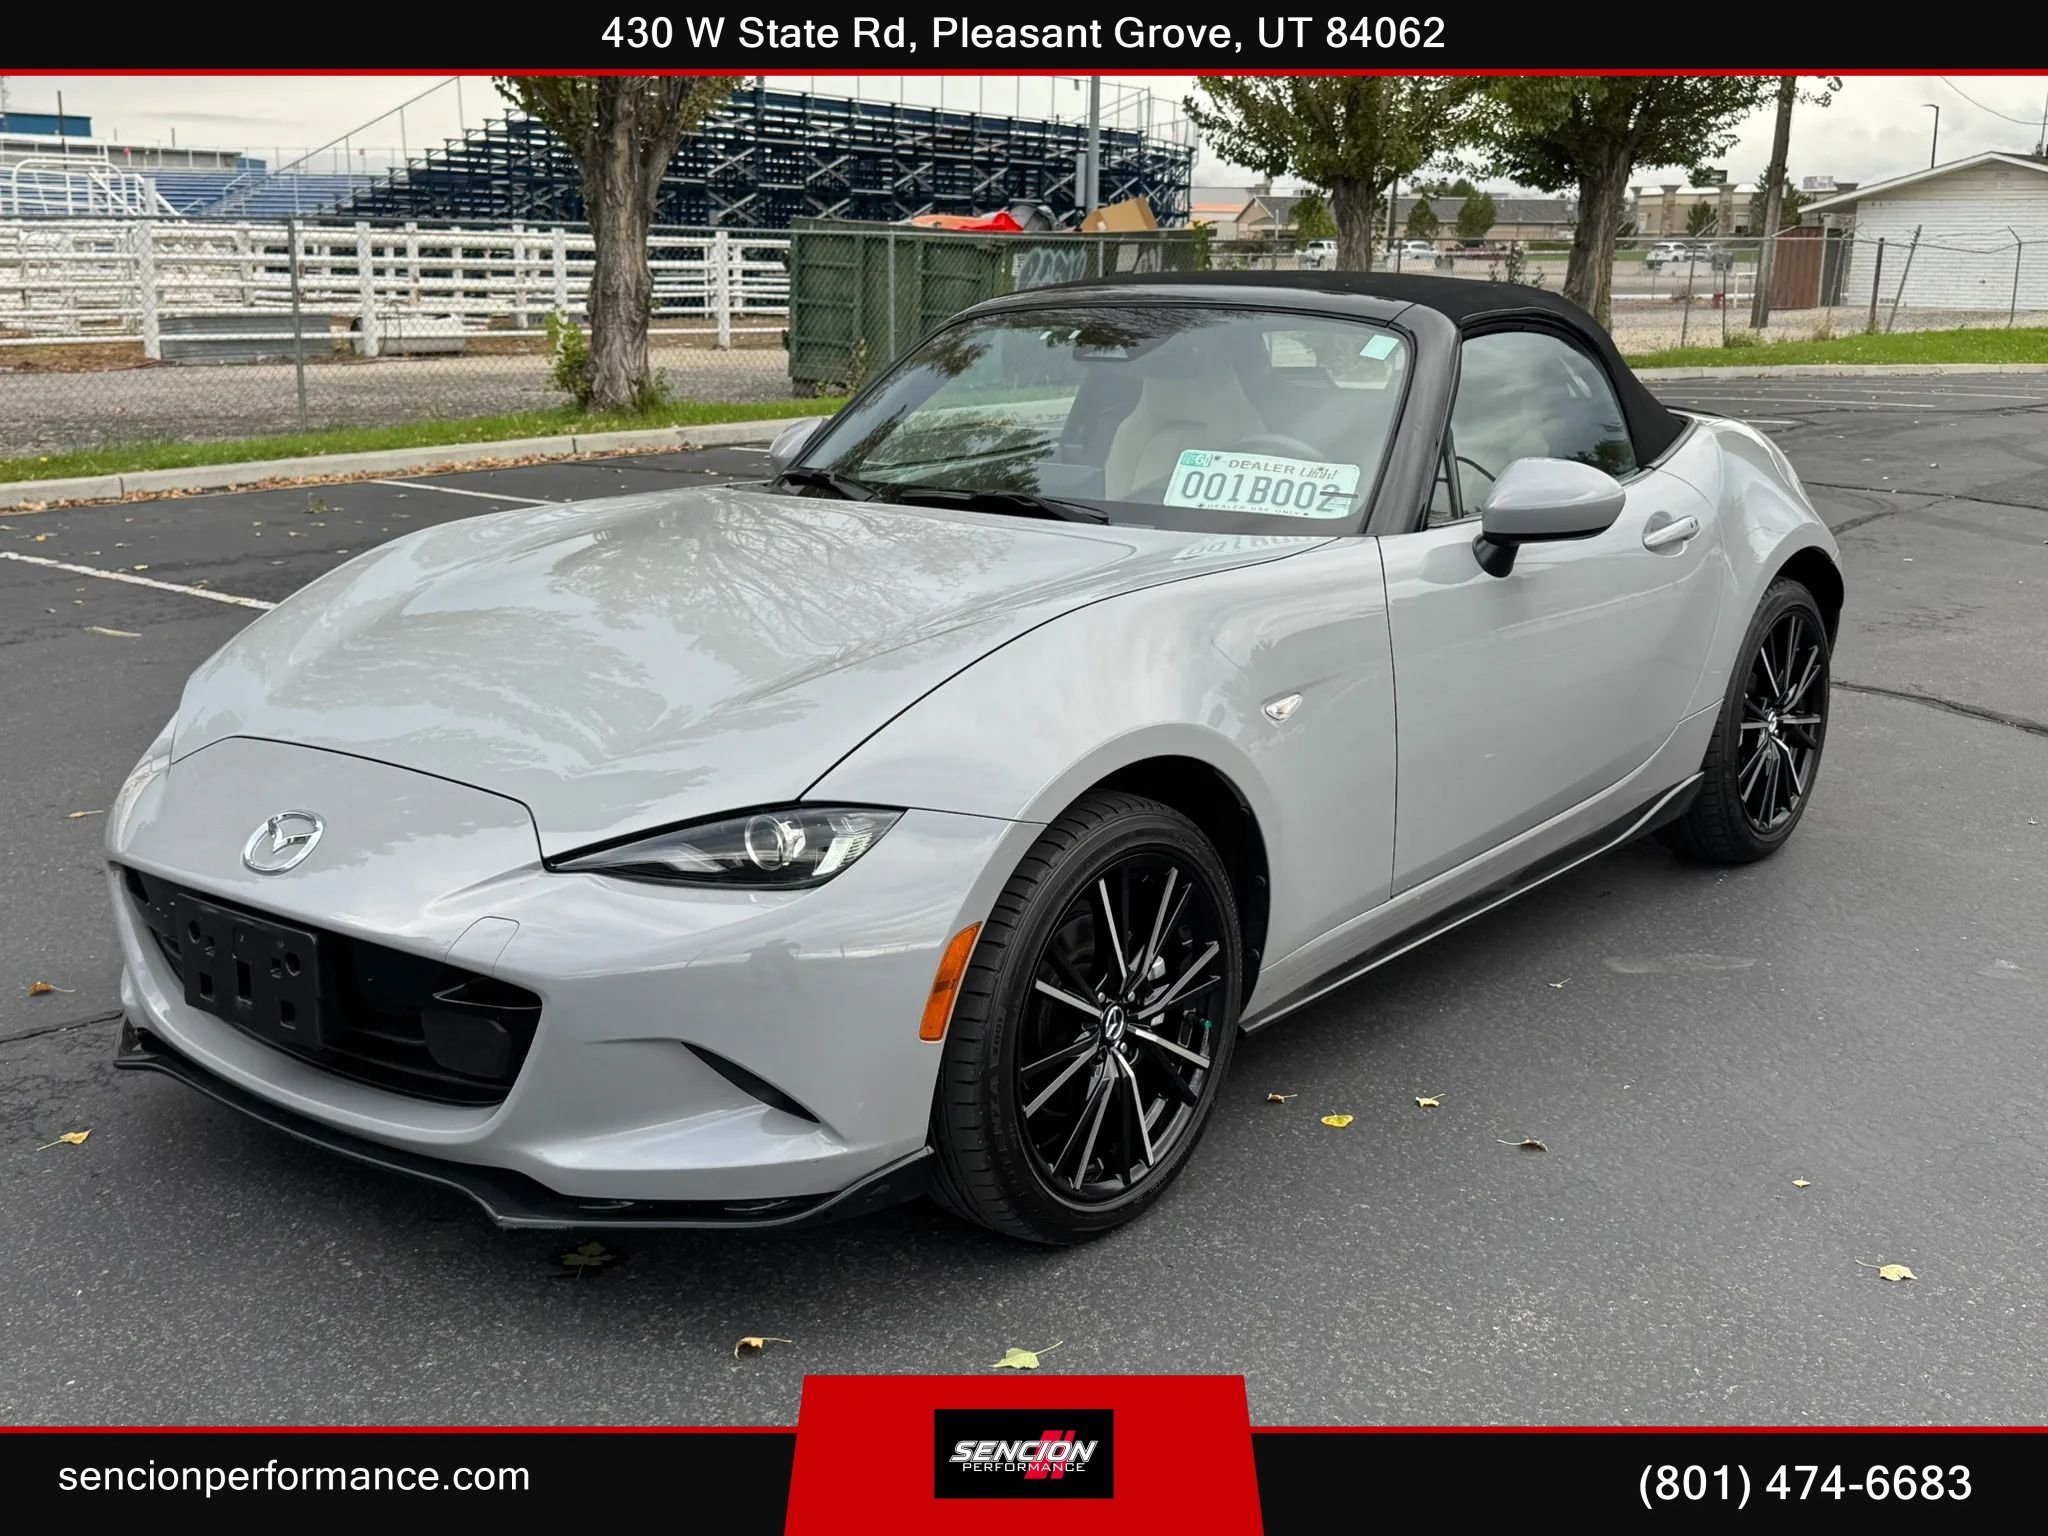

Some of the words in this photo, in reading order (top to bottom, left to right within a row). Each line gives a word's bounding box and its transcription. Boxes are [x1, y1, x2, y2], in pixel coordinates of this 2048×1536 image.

[1228, 459, 1296, 475] DEALER
[1180, 470, 1342, 513] 001B002
[1206, 503, 1246, 511] DEALER
[1274, 508, 1302, 516] ONLY
